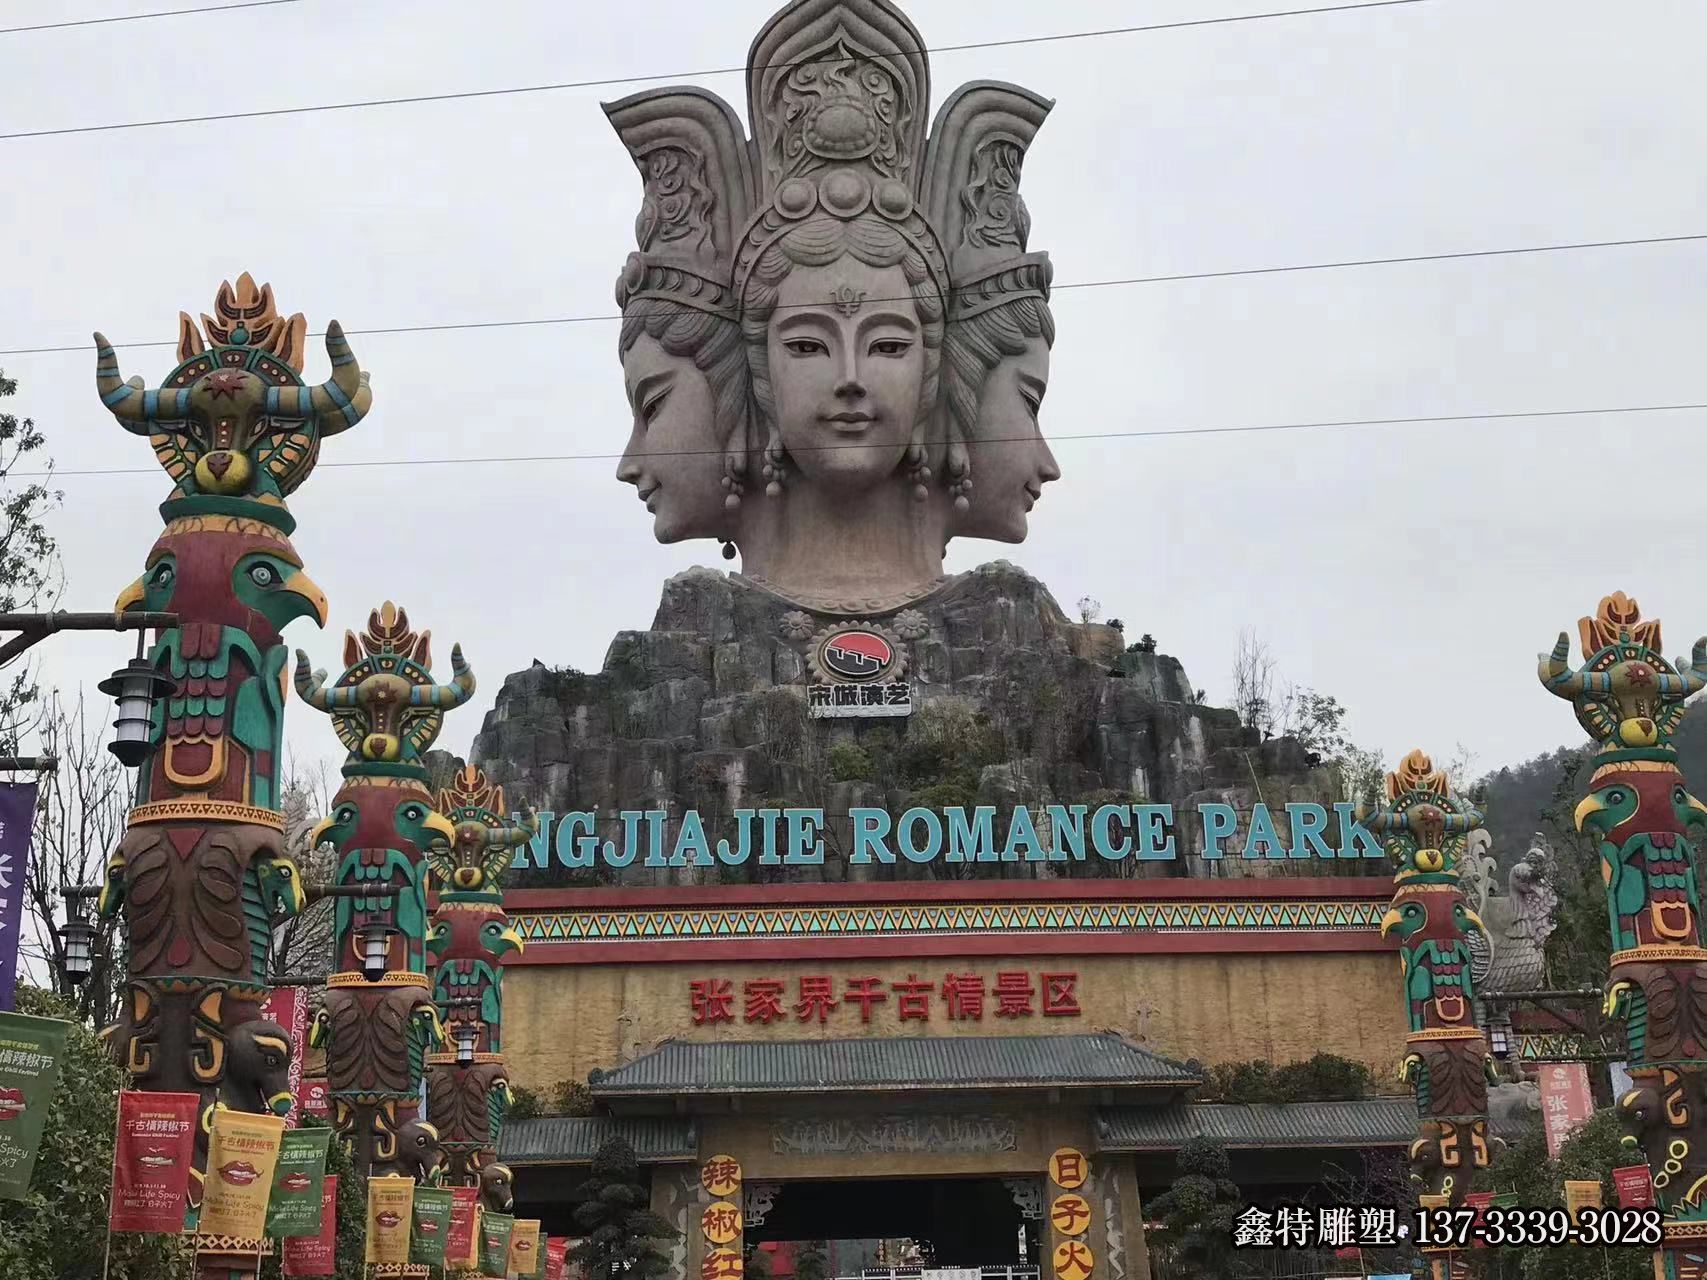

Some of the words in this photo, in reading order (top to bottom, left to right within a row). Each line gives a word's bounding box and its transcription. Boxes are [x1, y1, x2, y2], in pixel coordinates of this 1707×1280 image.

[808, 683, 910, 706] 宋城演艺
[849, 803, 1176, 864] ROMANCE
[1198, 802, 1384, 860] PARK
[688, 971, 1082, 1025] 张家界千古情景区
[0, 1142, 29, 1159] Spicy
[139, 1189, 156, 1199] Life
[157, 1189, 181, 1201] Spicy
[702, 1159, 743, 1280] 辣椒红
[1051, 1152, 1095, 1274] 日子火
